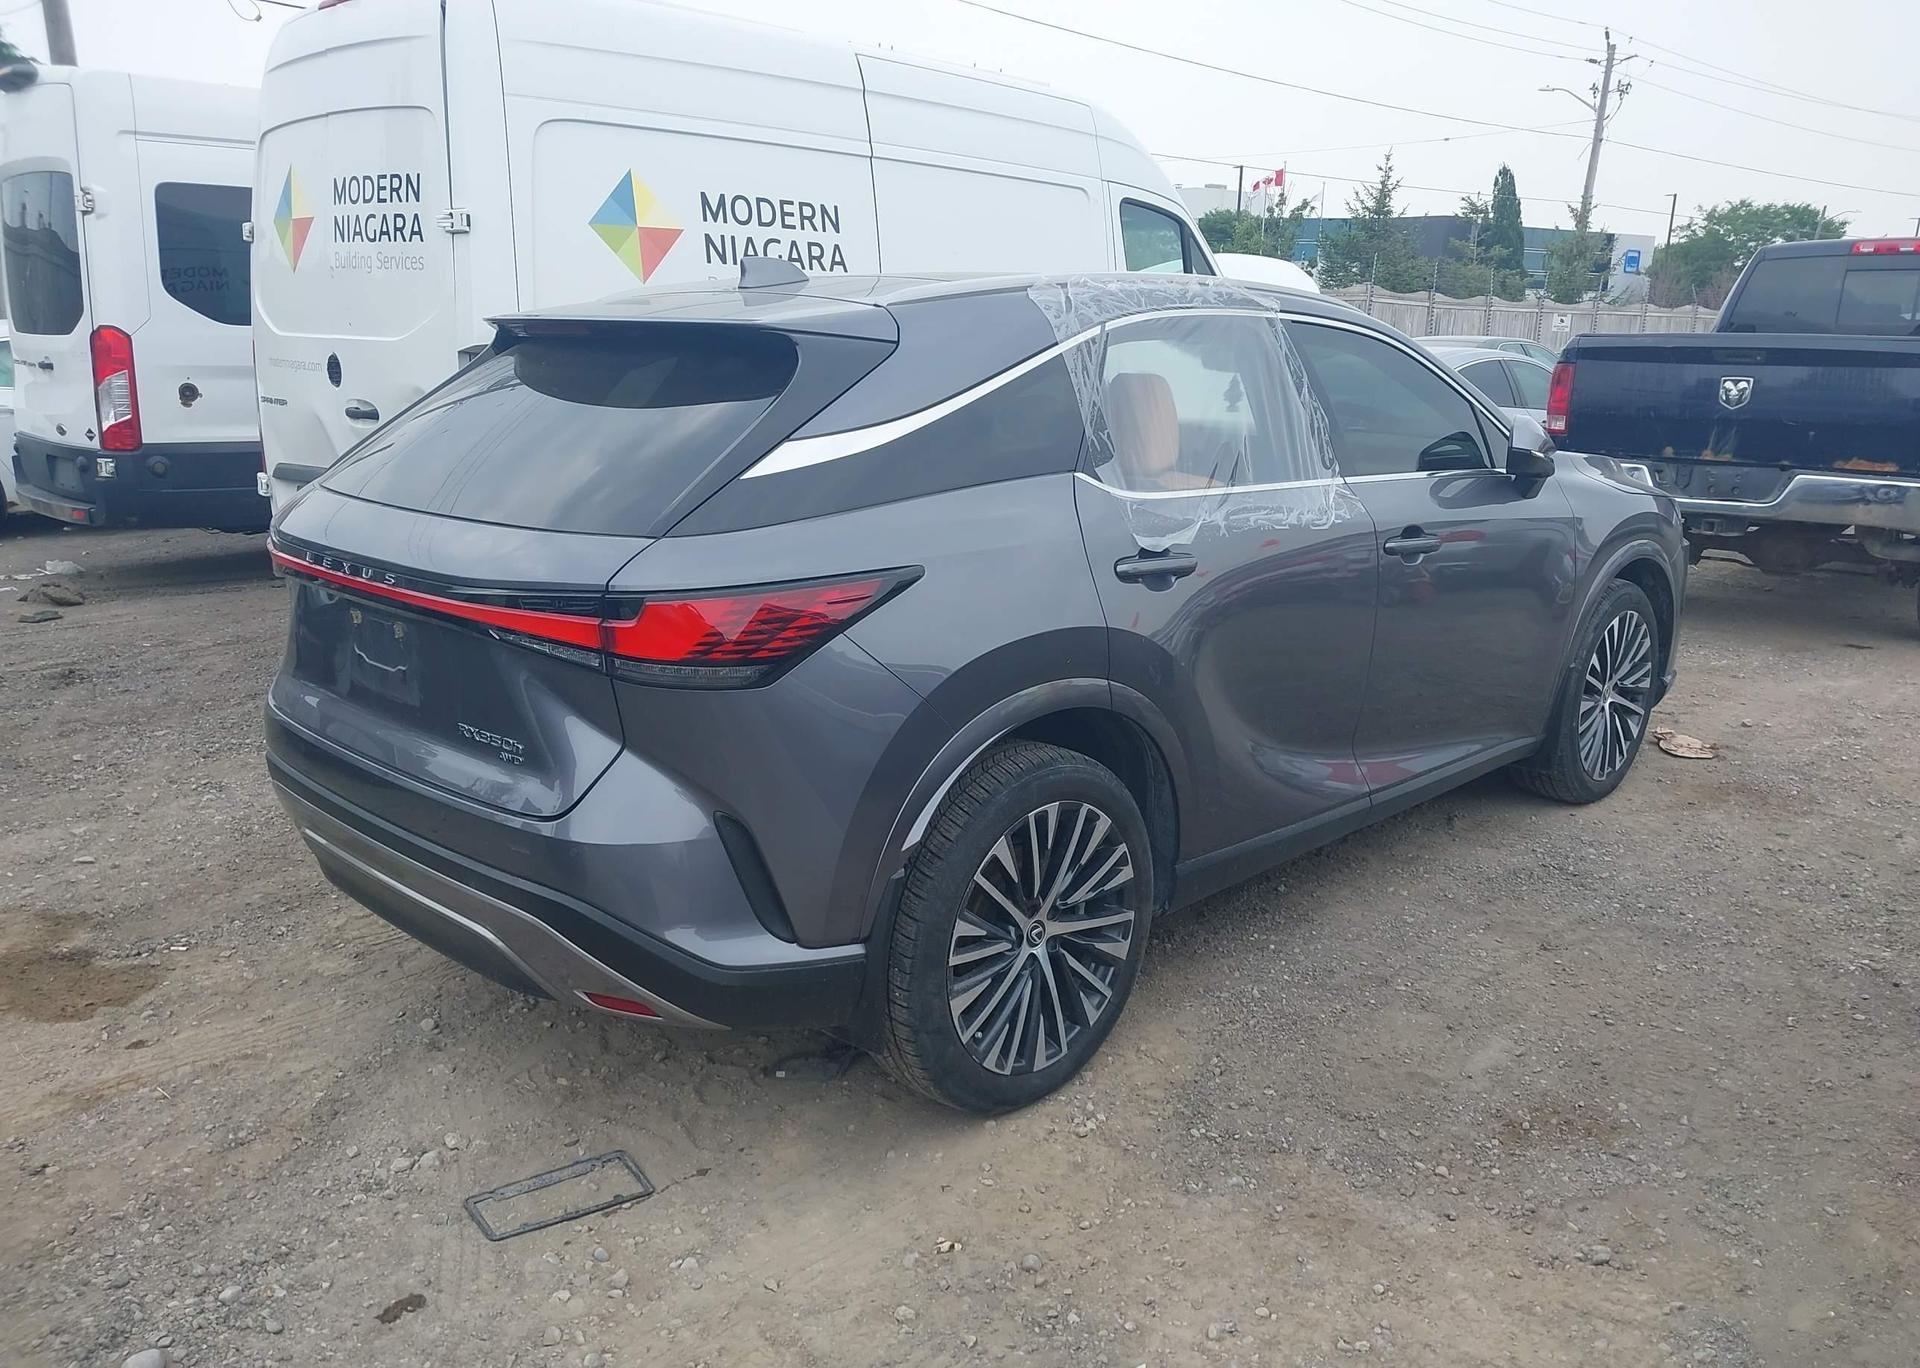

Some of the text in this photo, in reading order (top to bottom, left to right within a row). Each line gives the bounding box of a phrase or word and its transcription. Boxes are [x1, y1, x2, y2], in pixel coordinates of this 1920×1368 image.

[333, 172, 421, 206] MODERN
[333, 212, 424, 243] NIAGARA
[699, 191, 840, 234] MODERN
[334, 250, 425, 274] Building Services
[703, 232, 849, 273] NIAGARA
[305, 551, 396, 585] LEXUS
[457, 722, 524, 754] RX350h
[499, 751, 524, 765] AWD
